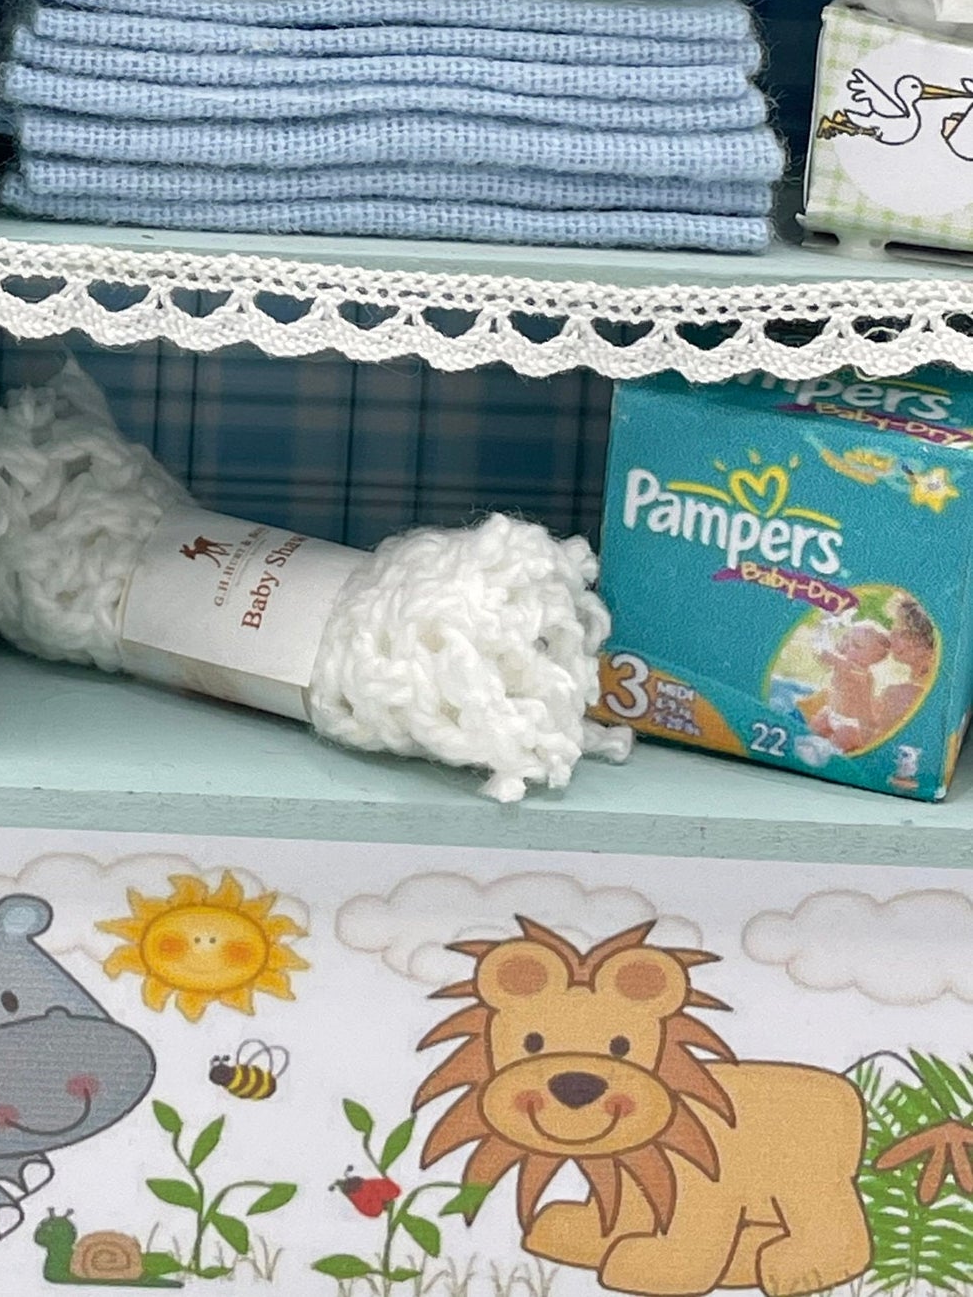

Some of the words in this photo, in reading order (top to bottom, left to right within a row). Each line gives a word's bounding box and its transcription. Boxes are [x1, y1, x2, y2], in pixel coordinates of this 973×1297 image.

[815, 402, 962, 444] Baby-Dry
[622, 468, 844, 575] Pampers
[240, 570, 280, 630] Baby
[741, 561, 851, 616] Baby-Dry
[605, 653, 649, 719] 3
[750, 722, 787, 757] 22
